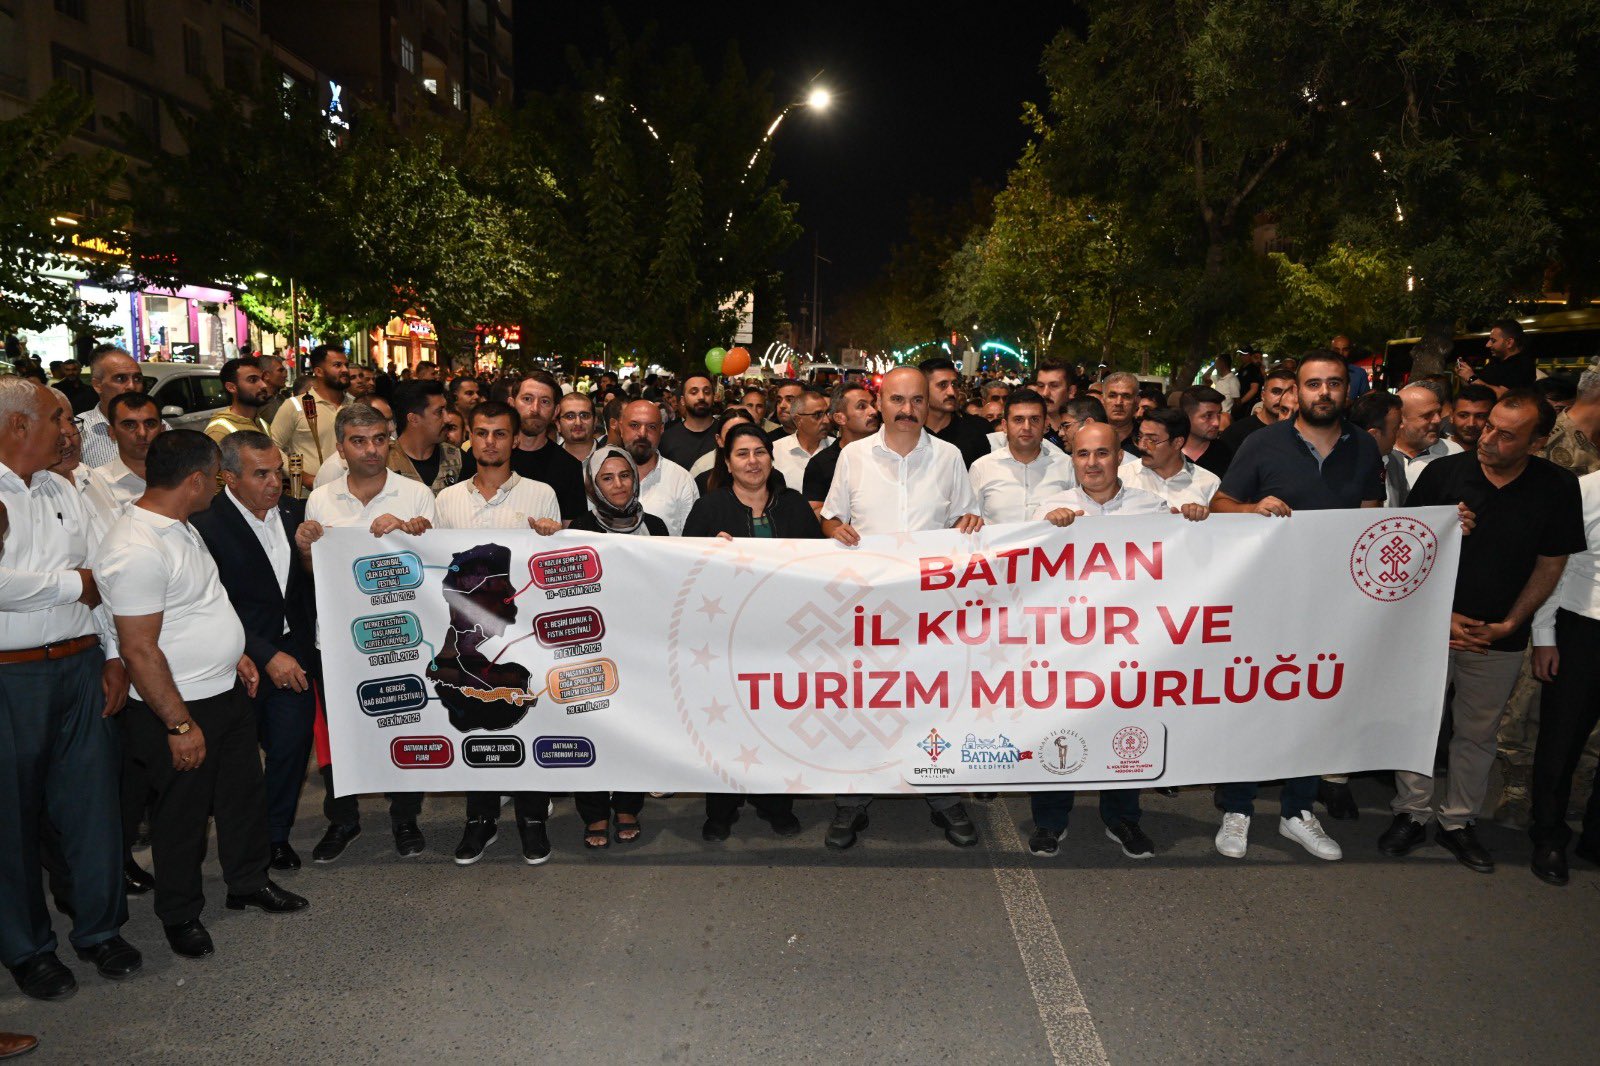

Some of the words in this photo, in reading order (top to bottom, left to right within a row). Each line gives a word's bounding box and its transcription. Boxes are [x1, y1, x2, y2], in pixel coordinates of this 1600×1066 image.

[919, 541, 1164, 592] BATMAN
[371, 596, 380, 606] 05
[381, 592, 398, 604] EKİM
[399, 591, 416, 601] 2025
[545, 591, 554, 600] 18
[559, 590, 567, 598] 19
[568, 586, 584, 596] EKİM
[584, 583, 601, 594] 2025
[364, 620, 384, 629] MERKEZ
[550, 618, 568, 628] BEŞİRİ
[854, 604, 899, 646] İL
[918, 596, 1139, 646] KÜLTÜR
[1158, 605, 1234, 645] VE
[565, 624, 591, 635] FESTİVALİ
[378, 651, 400, 665] EYLÜL
[400, 650, 419, 661] 2025
[563, 646, 583, 658] EYLÜL
[584, 643, 602, 654] 2025
[559, 679, 573, 689] DOĞA
[573, 676, 598, 686] SPORLARI
[738, 660, 948, 710] TURİZM
[971, 653, 1345, 710] MÜDÜRLÜĞÜ
[397, 690, 425, 701] FESTİVALİ
[576, 701, 593, 713] EYLÜL
[403, 713, 421, 724] 2025
[961, 749, 1021, 763] BATMAN
